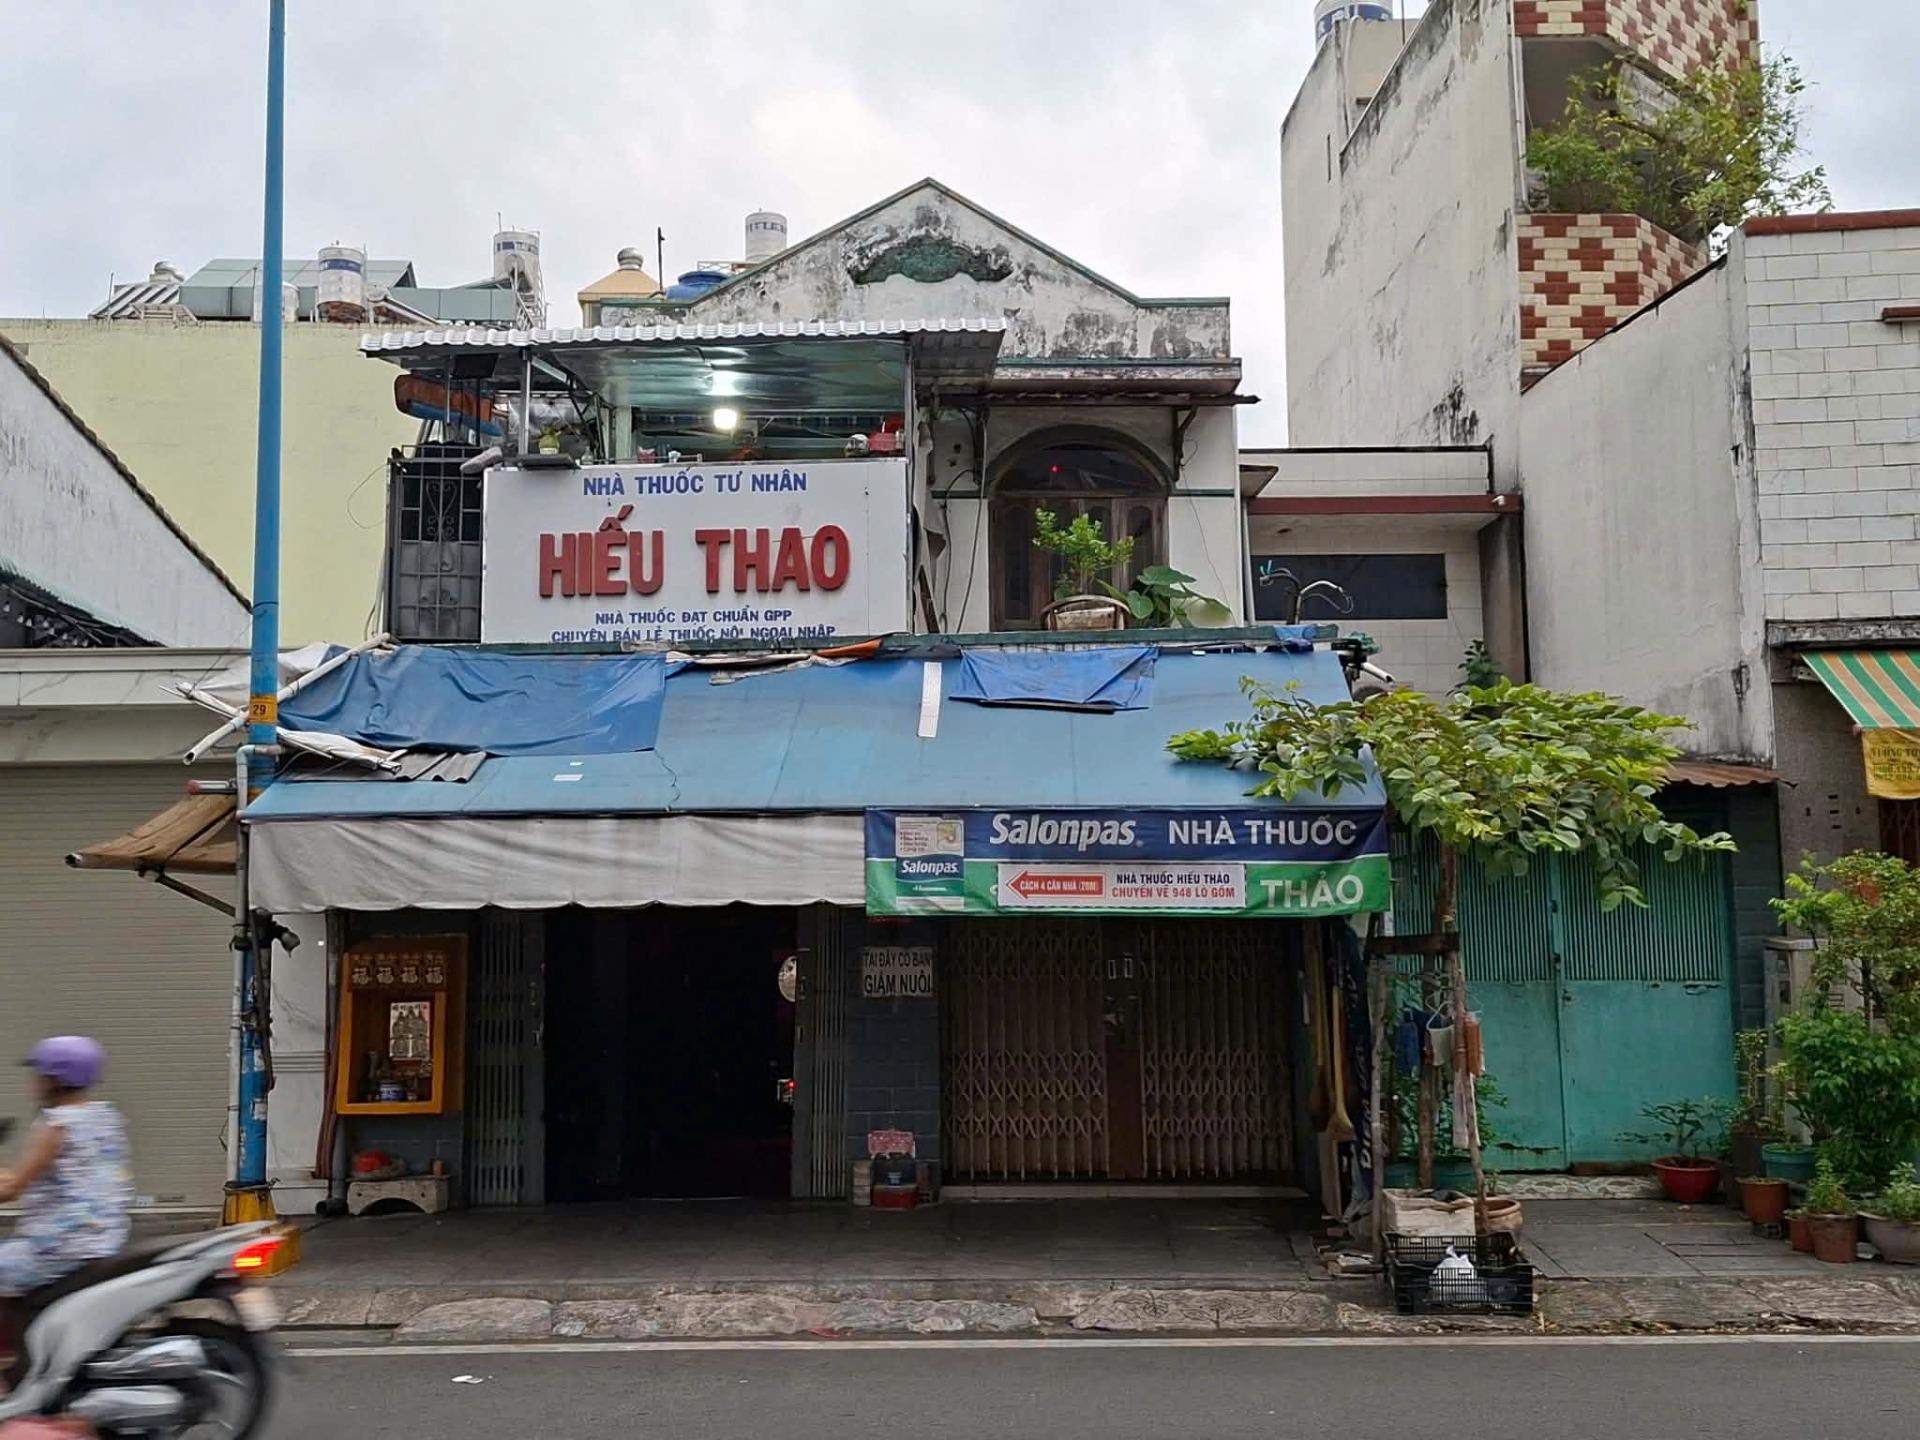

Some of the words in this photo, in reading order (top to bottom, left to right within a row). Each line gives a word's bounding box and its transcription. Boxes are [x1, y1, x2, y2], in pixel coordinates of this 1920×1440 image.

[583, 472, 625, 496] NHÀ
[634, 466, 704, 494] THUỐC
[714, 471, 743, 493] TƯ
[751, 469, 807, 492] NHÂN
[539, 504, 664, 598] HIẾU
[595, 610, 624, 625] NHÀ
[628, 606, 676, 624] THUỐC
[681, 611, 708, 625] ĐẠT
[712, 605, 759, 622] CHUẨN
[763, 610, 793, 621] GPP
[989, 813, 1137, 852] Salonpas
[1169, 815, 1237, 845] NHÀ
[1243, 814, 1358, 845] THUỐC
[901, 860, 960, 876] Salonpas
[1172, 887, 1192, 898] 948
[1260, 870, 1364, 908] THẢO
